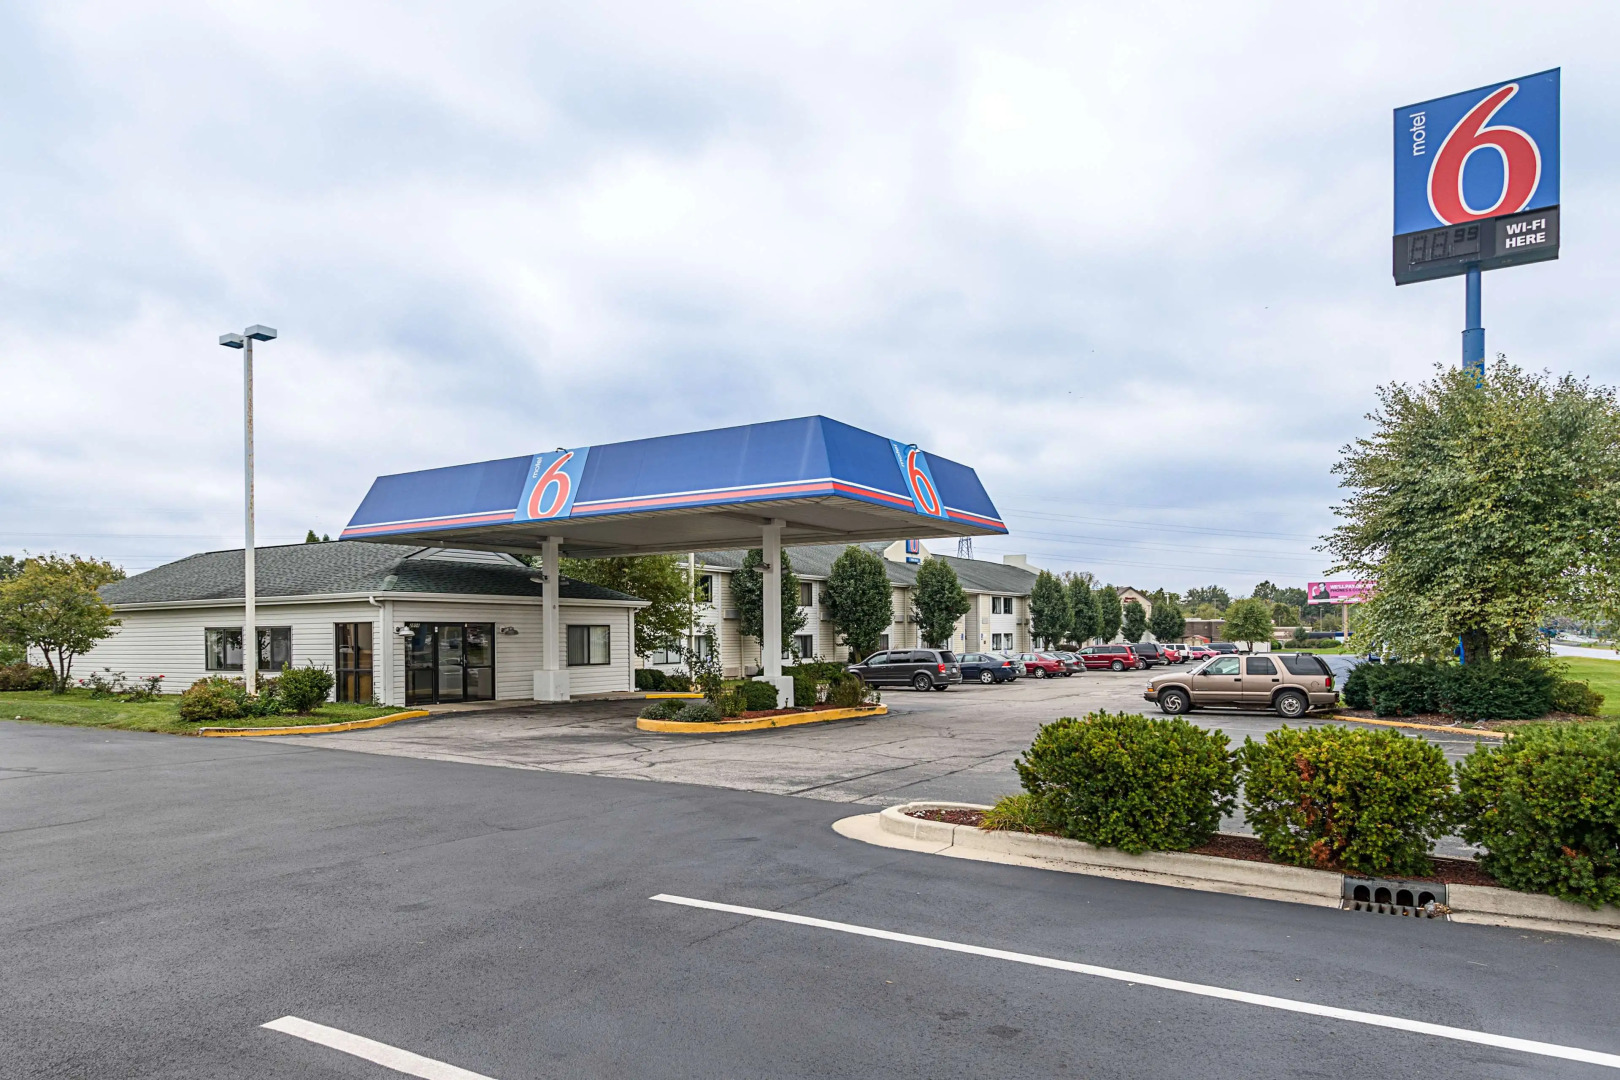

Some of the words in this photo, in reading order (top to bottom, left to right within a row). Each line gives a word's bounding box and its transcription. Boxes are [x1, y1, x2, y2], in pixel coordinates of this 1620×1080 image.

[1410, 111, 1425, 156] motel
[1427, 83, 1541, 225] 6
[1505, 232, 1546, 249] HERE
[1506, 218, 1546, 235] WI-FI
[527, 451, 574, 519] 6
[906, 449, 941, 516] 6
